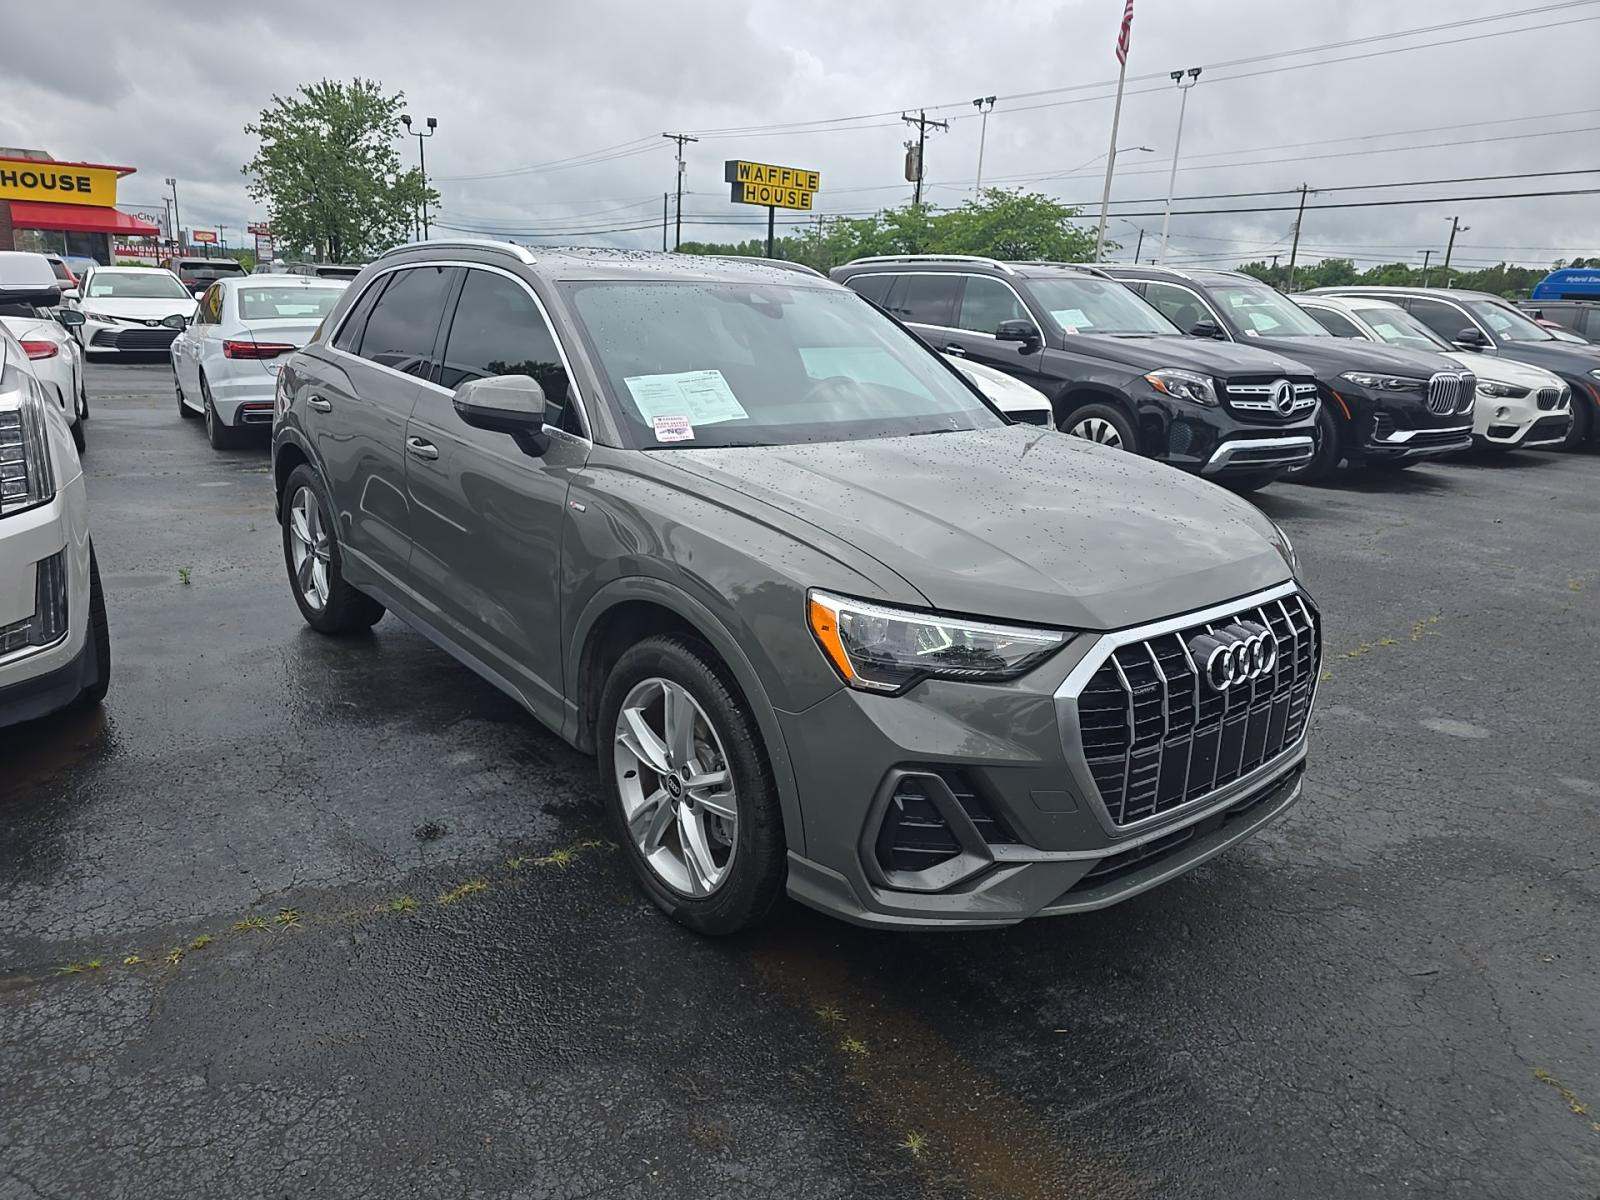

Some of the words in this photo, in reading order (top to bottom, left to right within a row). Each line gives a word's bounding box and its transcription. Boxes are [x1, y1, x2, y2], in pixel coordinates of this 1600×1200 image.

[0, 170, 92, 193] HOUSE
[739, 164, 817, 190] WAFFLE
[745, 184, 810, 208] HOUSE
